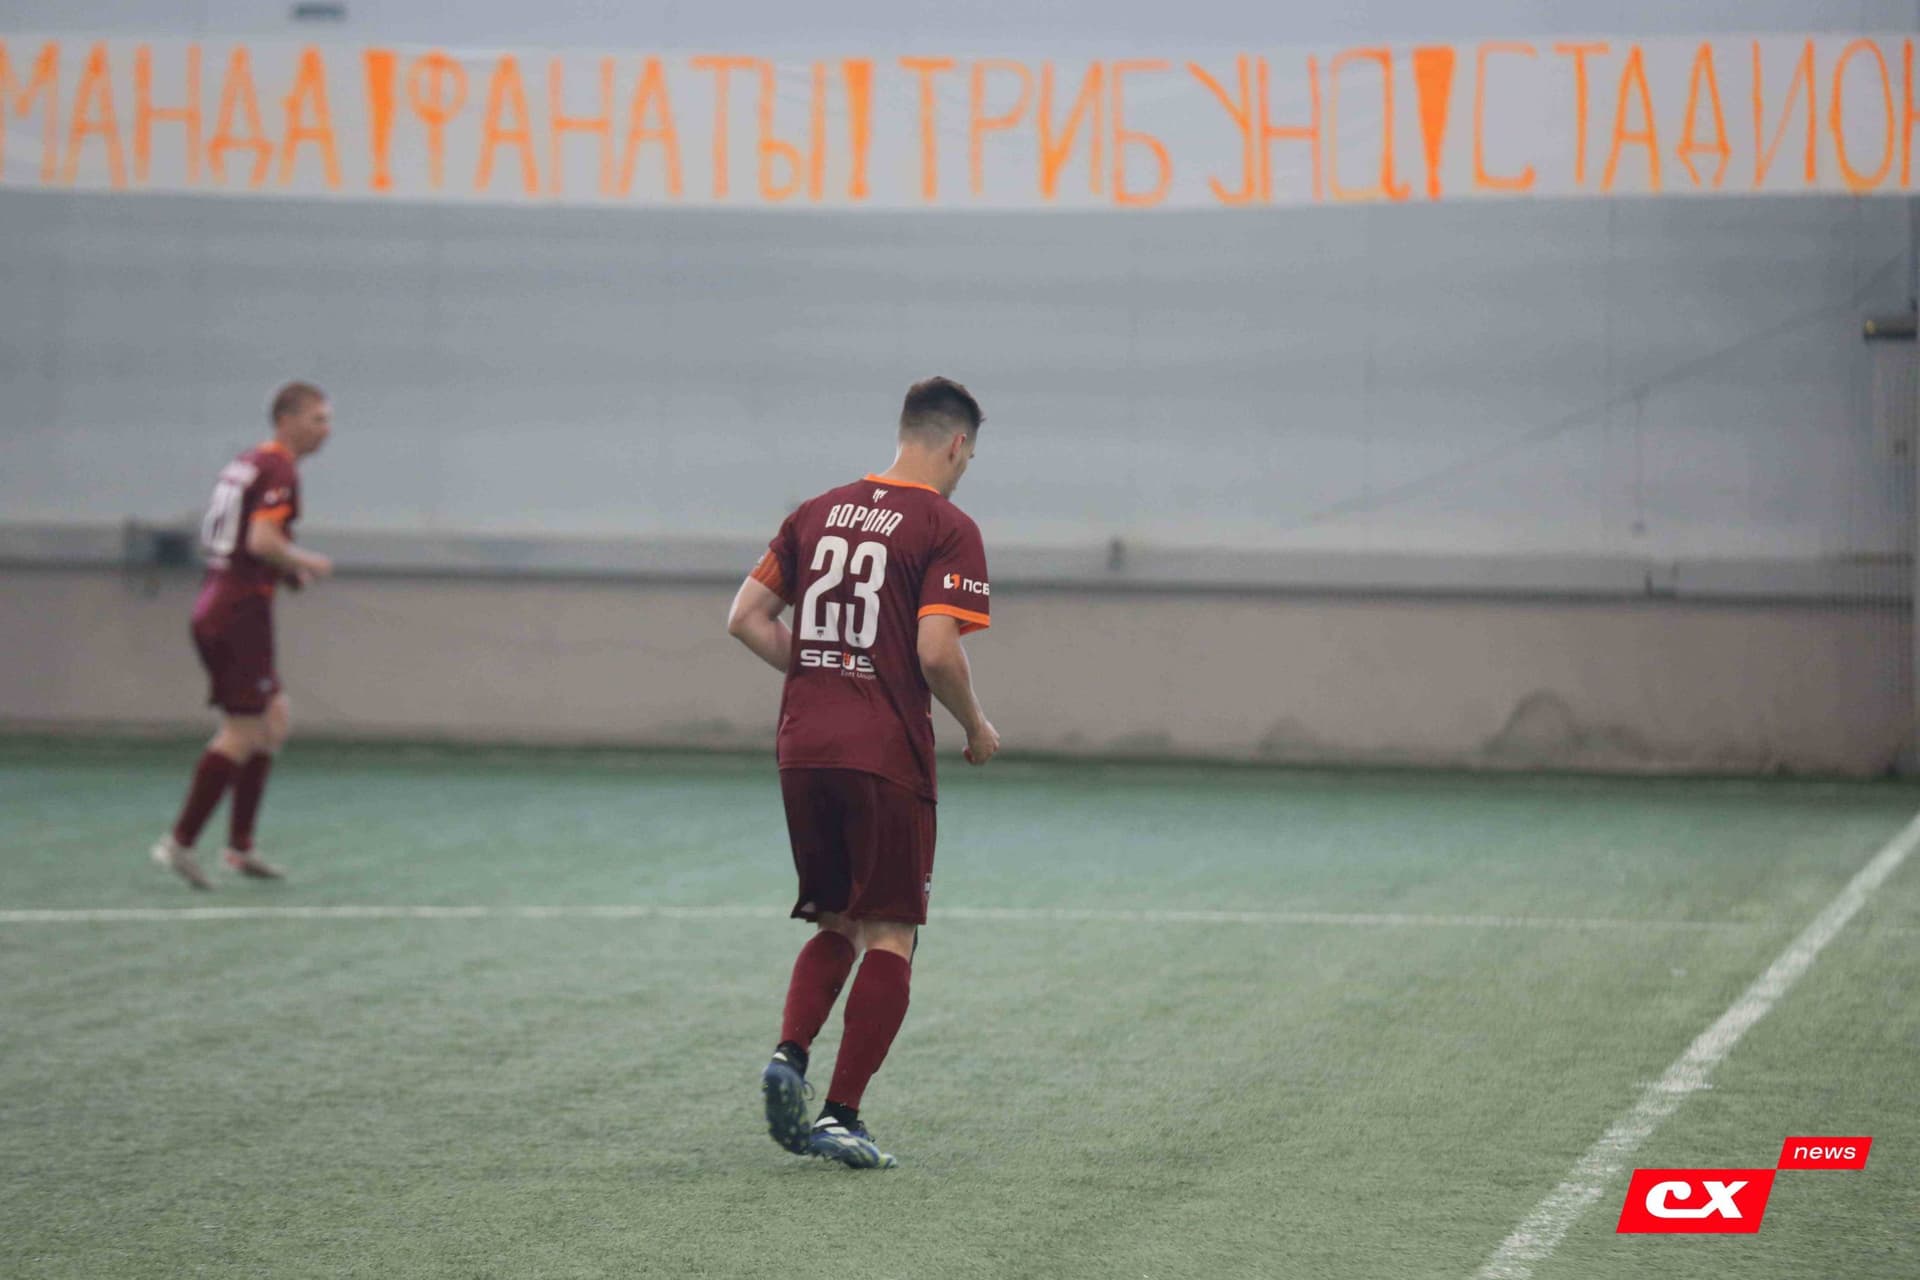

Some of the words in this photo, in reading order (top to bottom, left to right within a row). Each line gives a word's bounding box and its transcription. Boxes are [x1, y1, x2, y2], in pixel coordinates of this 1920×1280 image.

[825, 502, 903, 537] ВОРОНА
[800, 535, 887, 649] 23
[800, 649, 875, 673] SEUS
